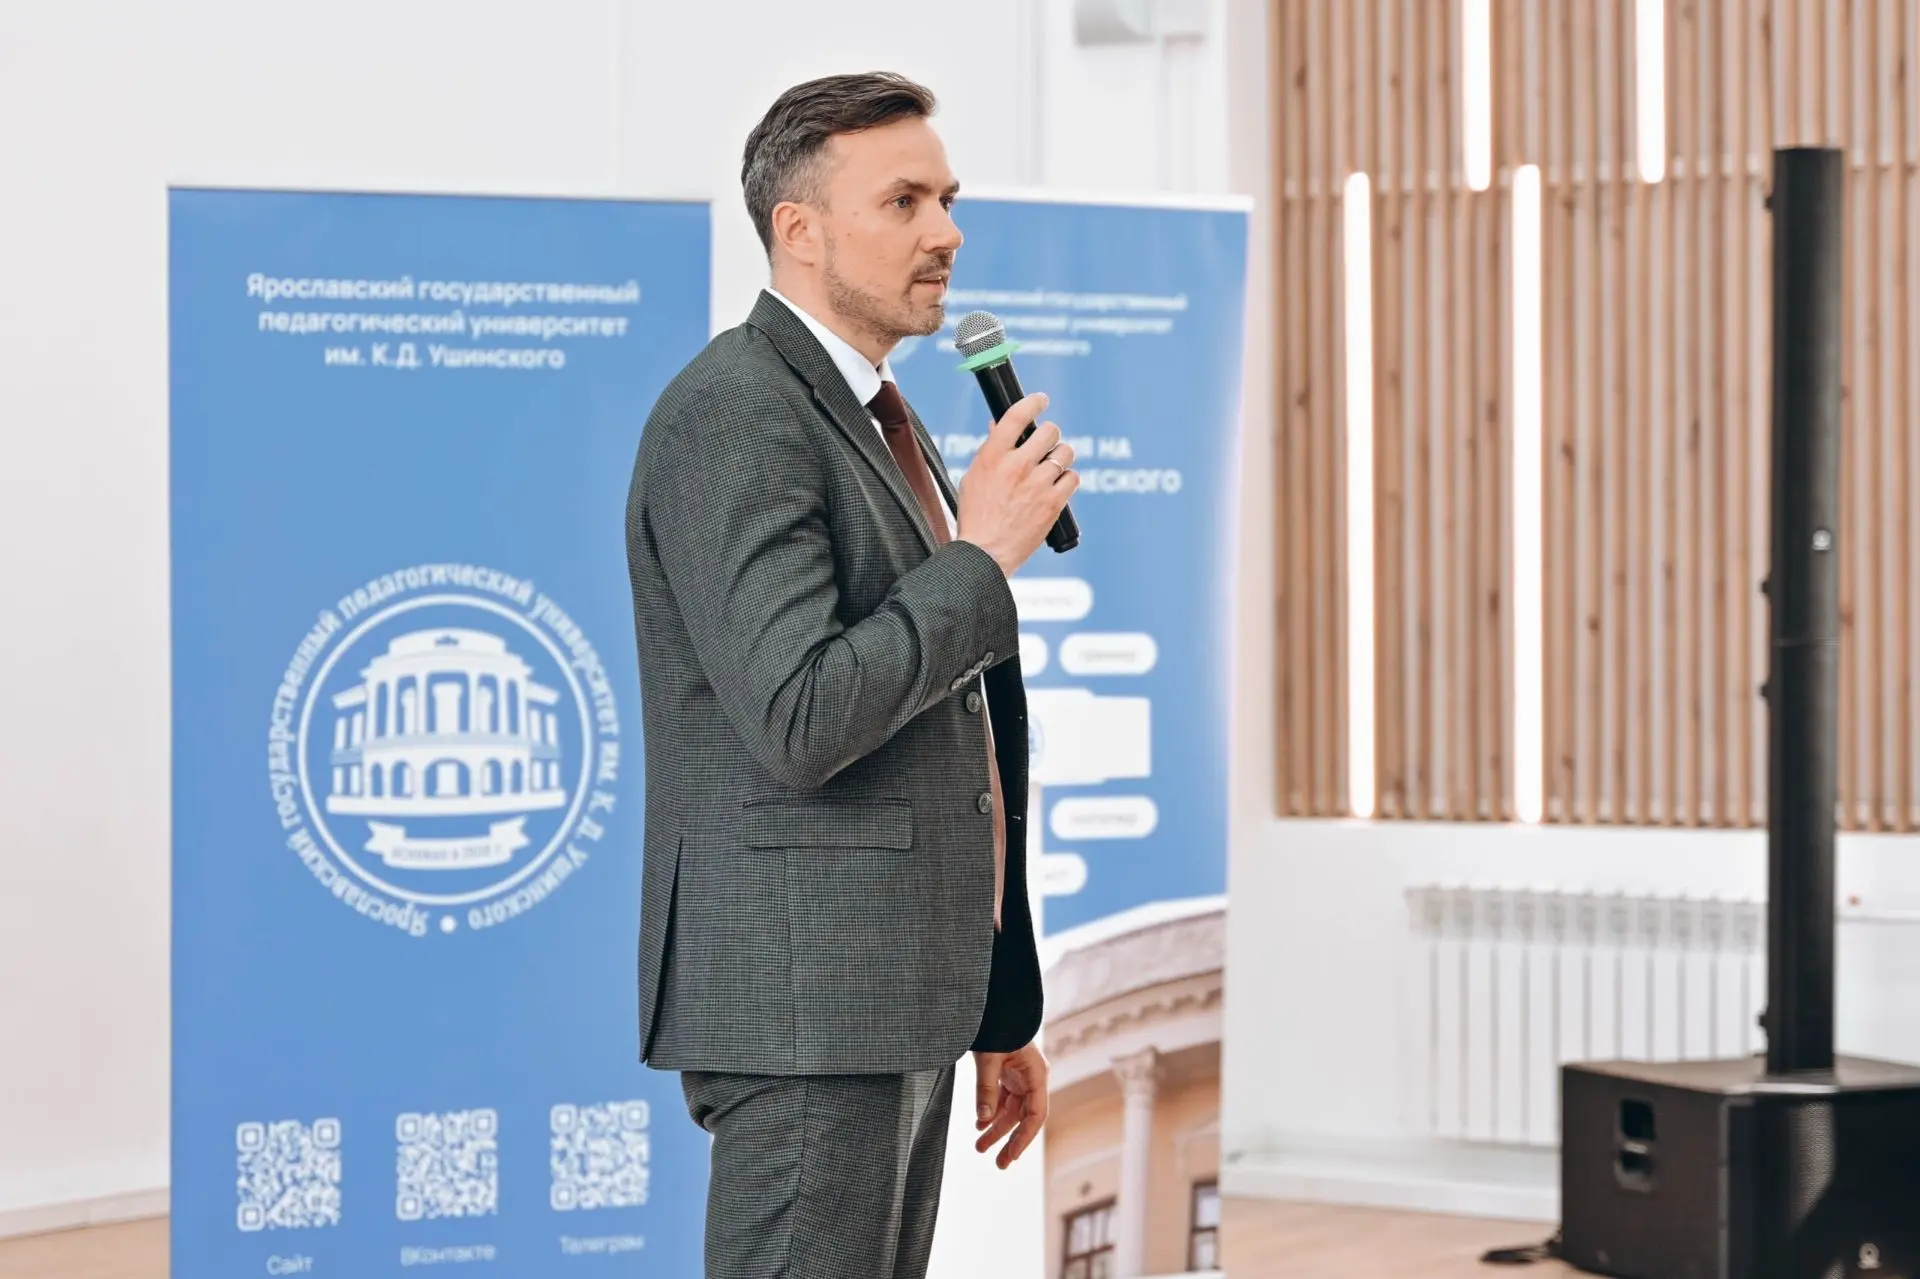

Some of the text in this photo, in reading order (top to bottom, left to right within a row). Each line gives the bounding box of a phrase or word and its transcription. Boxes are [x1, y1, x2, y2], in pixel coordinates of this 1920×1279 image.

[247, 272, 640, 308] Ярославский государственный
[259, 310, 629, 341] педагогический университет
[324, 346, 367, 366] им.
[427, 343, 567, 369] Ушинского
[337, 563, 535, 621] педагогический
[522, 591, 620, 736] университет
[267, 608, 343, 830] государственный
[286, 827, 430, 937] Ярославский
[467, 842, 589, 931] Ушинского
[265, 1253, 314, 1275] Сайт
[400, 1244, 497, 1267] ВКонтакте
